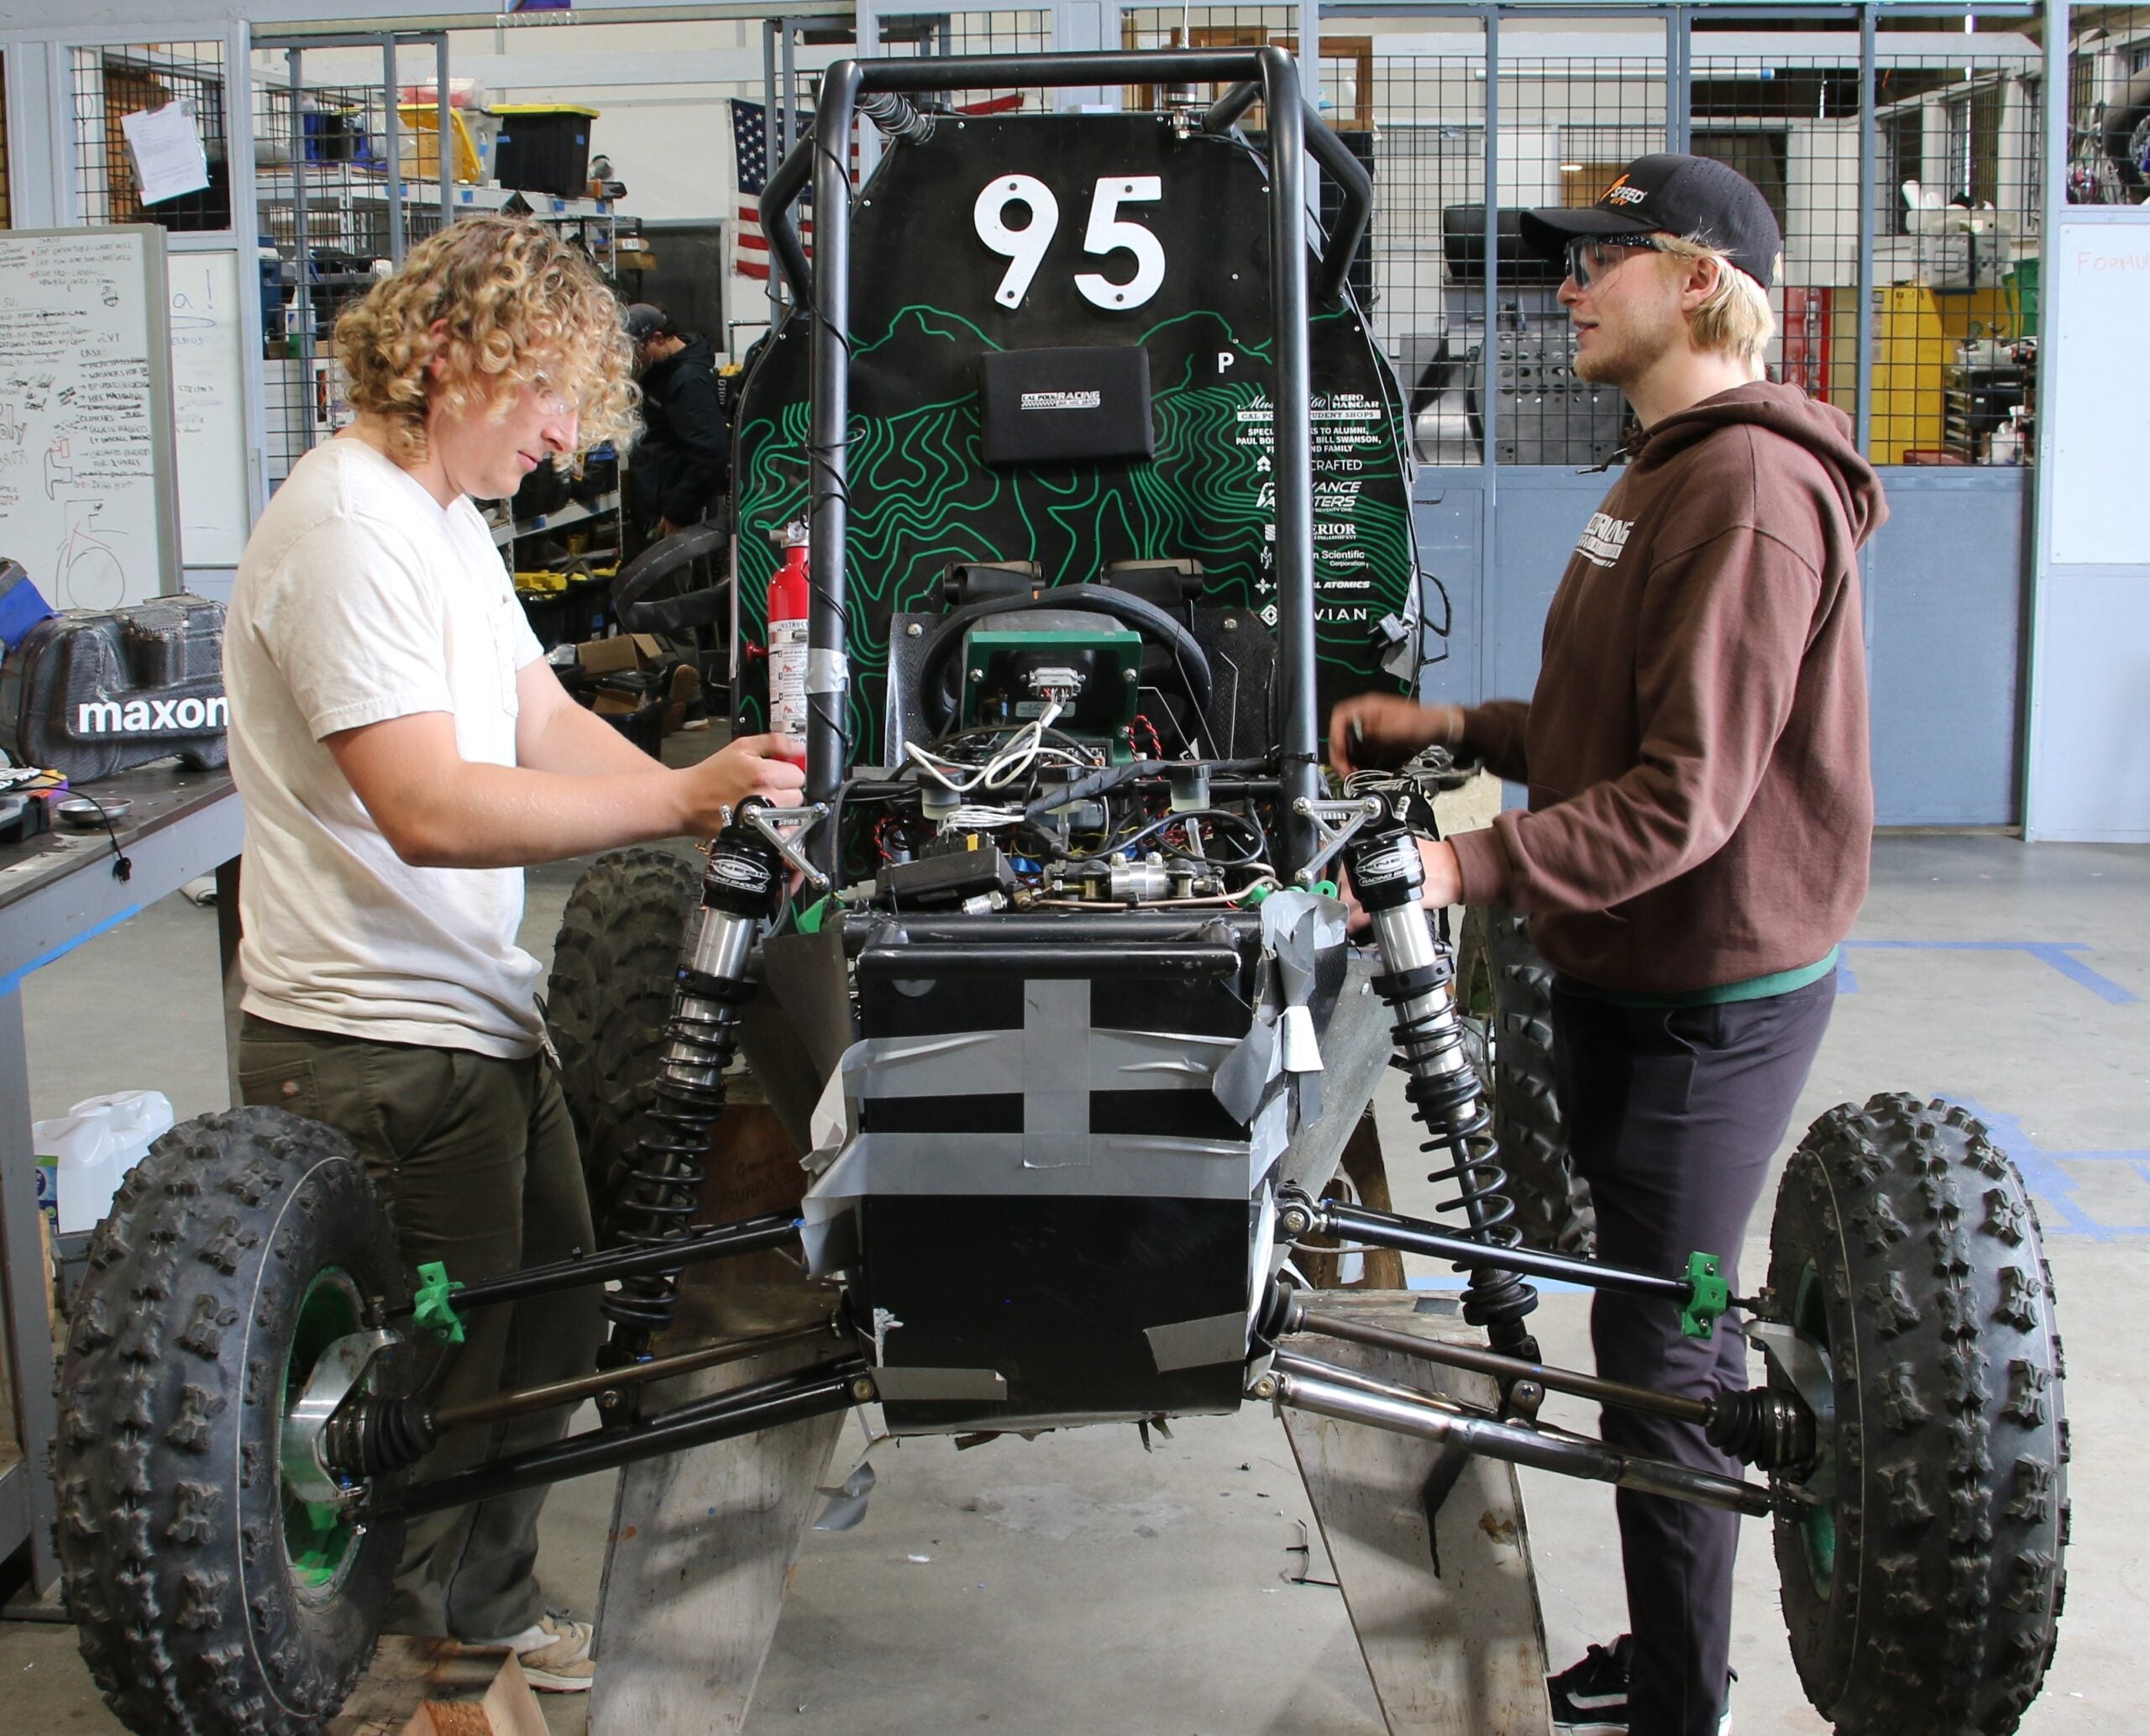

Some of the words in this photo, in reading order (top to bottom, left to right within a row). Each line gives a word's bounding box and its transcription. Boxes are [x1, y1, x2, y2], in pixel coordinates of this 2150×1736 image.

[496, 12, 579, 28] RIVIAN
[1610, 186, 1644, 204] SPEED
[974, 174, 1166, 310] 95
[2077, 251, 2150, 277] FORMU
[1218, 352, 1235, 374] P
[1058, 391, 1100, 400] RACING
[1333, 427, 1369, 436] ALUMNI,
[1335, 435, 1382, 444] SWANSON,
[1324, 444, 1354, 453] FAMILY
[1321, 549, 1366, 559] Scientific
[1323, 580, 1371, 589] ATOMICS
[79, 696, 230, 733] maxon
